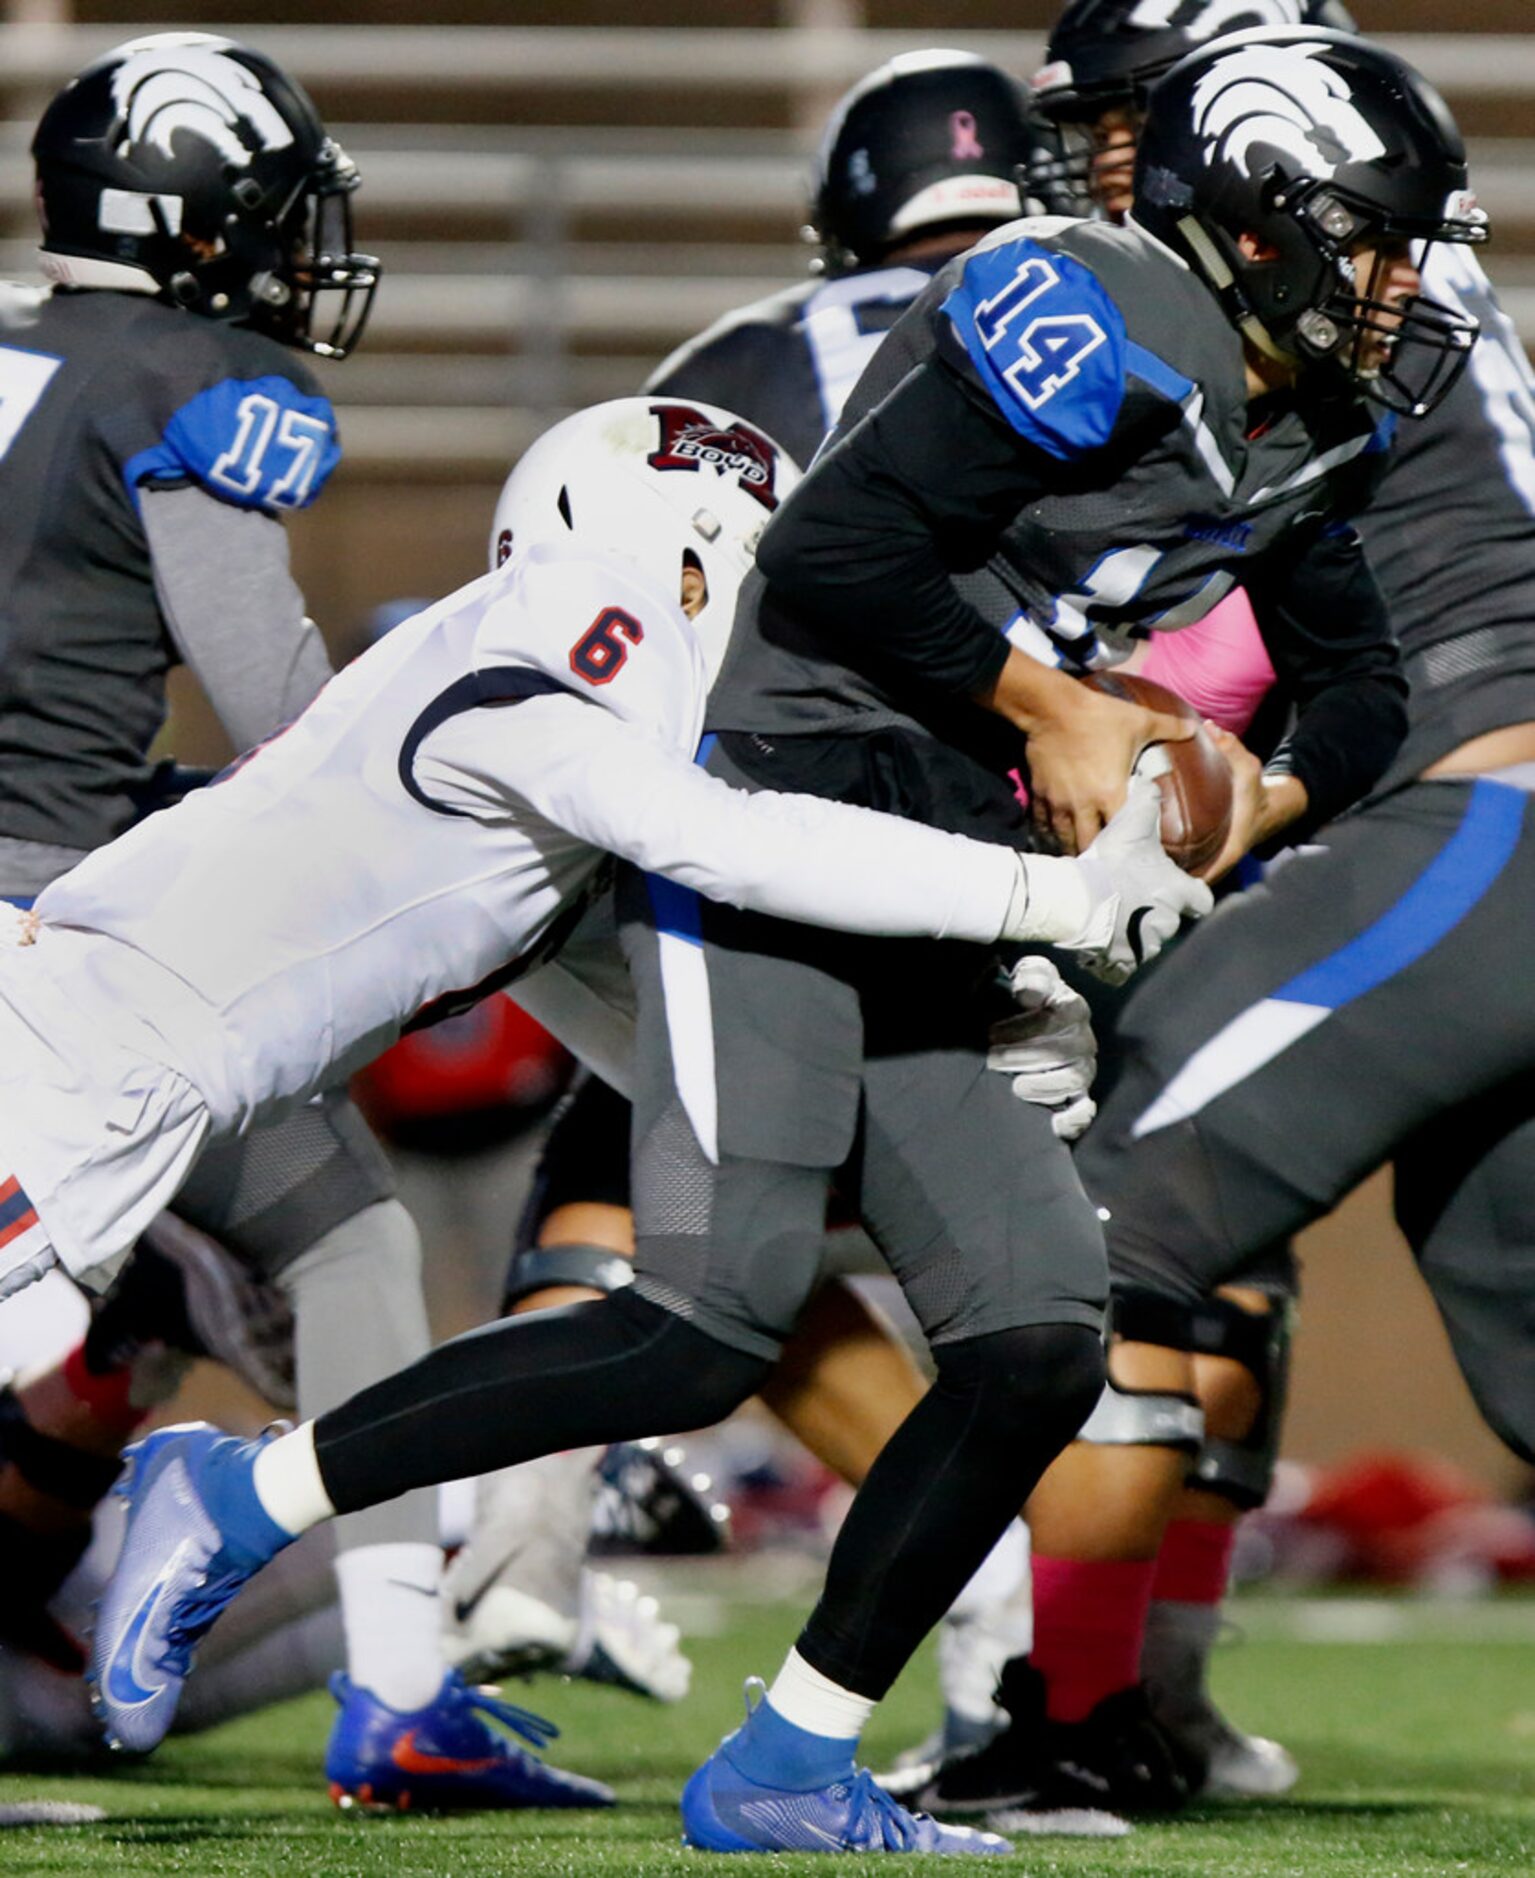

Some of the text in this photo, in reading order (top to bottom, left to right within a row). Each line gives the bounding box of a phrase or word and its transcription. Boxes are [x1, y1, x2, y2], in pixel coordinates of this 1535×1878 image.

[974, 258, 1107, 411] 14
[209, 393, 330, 509] 17
[669, 439, 769, 486] BOYD
[569, 605, 644, 686] 6
